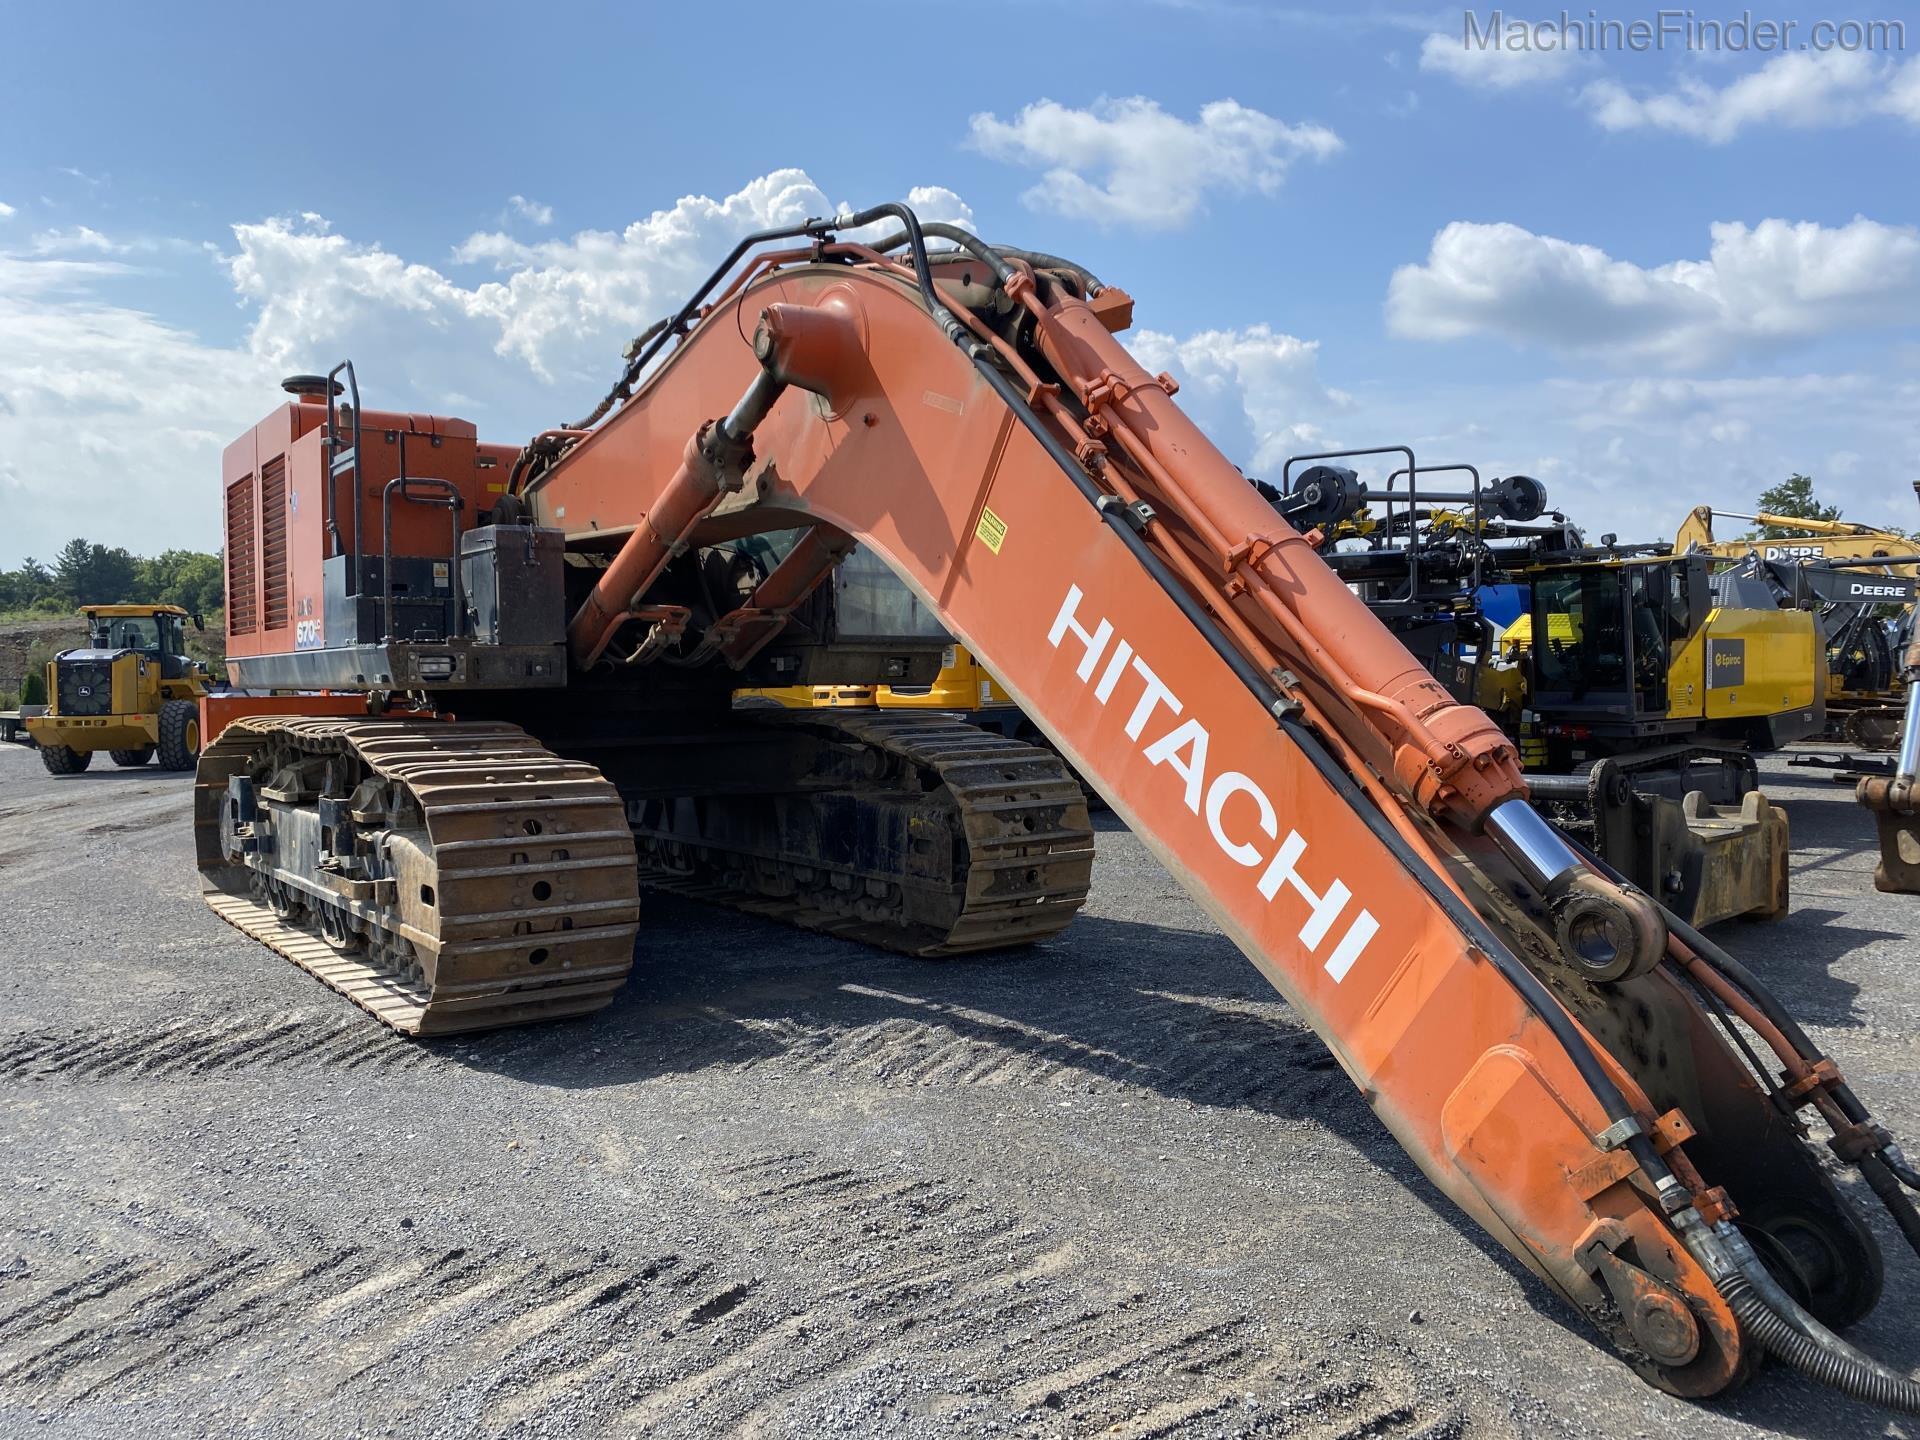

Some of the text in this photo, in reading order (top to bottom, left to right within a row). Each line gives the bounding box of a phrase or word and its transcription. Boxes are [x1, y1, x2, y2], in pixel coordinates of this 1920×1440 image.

[984, 510, 1004, 535] WARNING
[1850, 583, 1907, 597] DEERE
[1722, 653, 1741, 668] Epiroc
[1047, 583, 1380, 984] HITACHI
